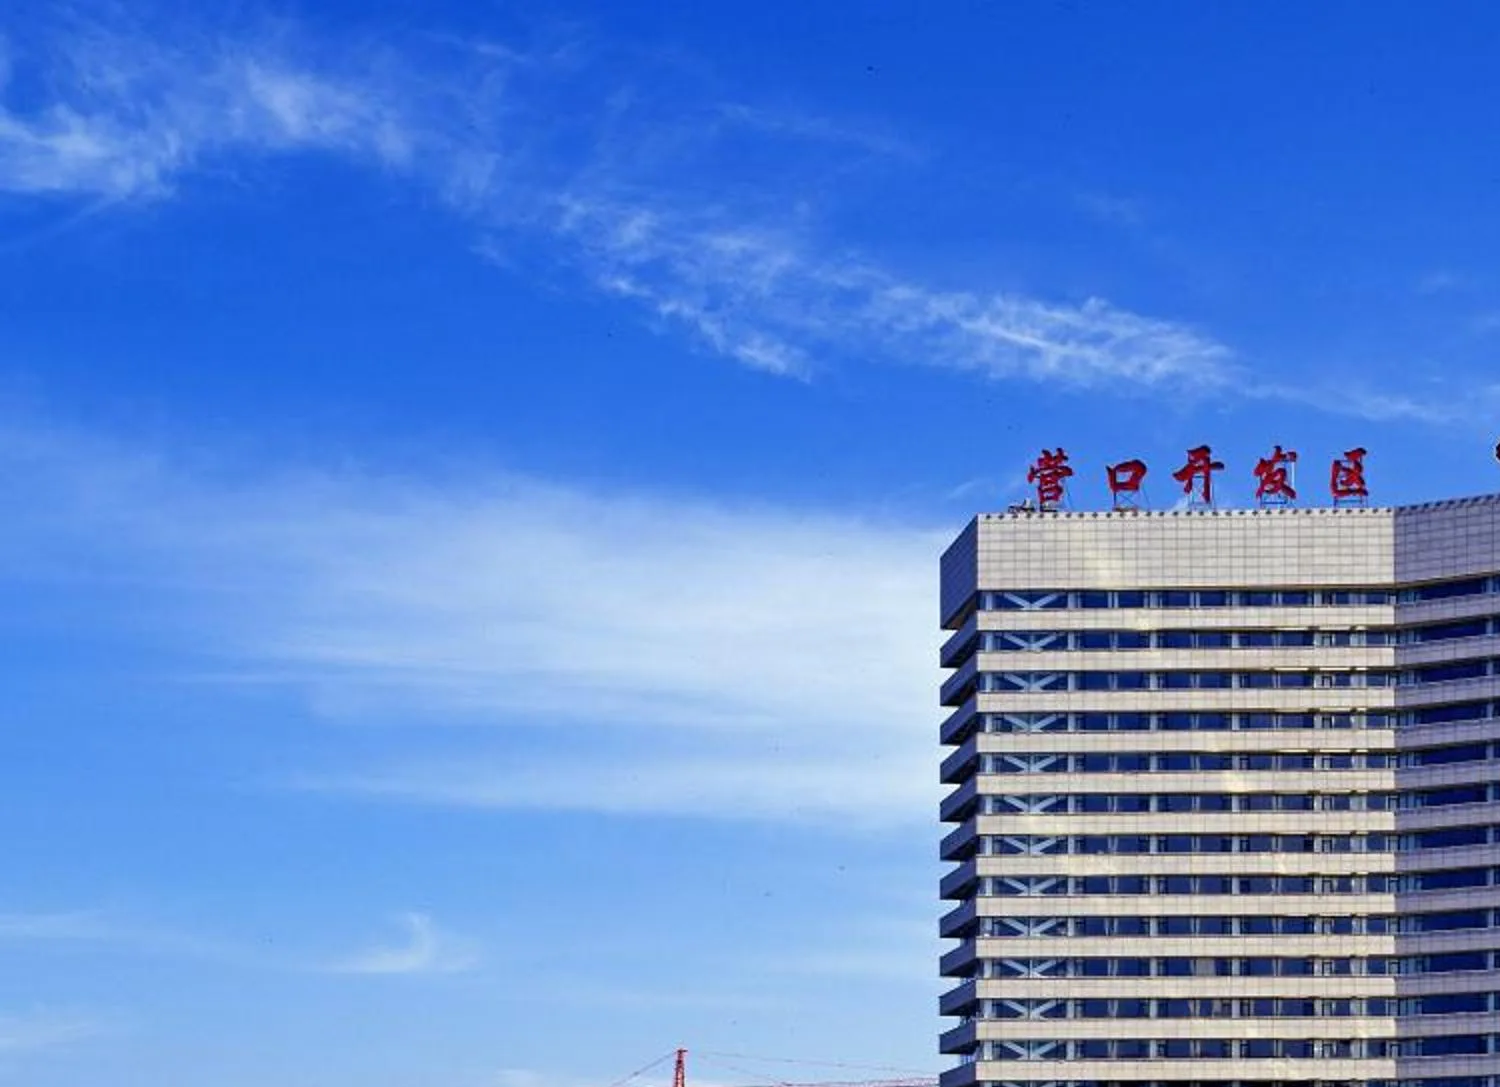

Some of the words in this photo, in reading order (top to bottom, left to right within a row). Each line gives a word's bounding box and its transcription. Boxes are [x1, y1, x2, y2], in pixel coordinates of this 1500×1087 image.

[1028, 445, 1368, 503] 营口开发区
